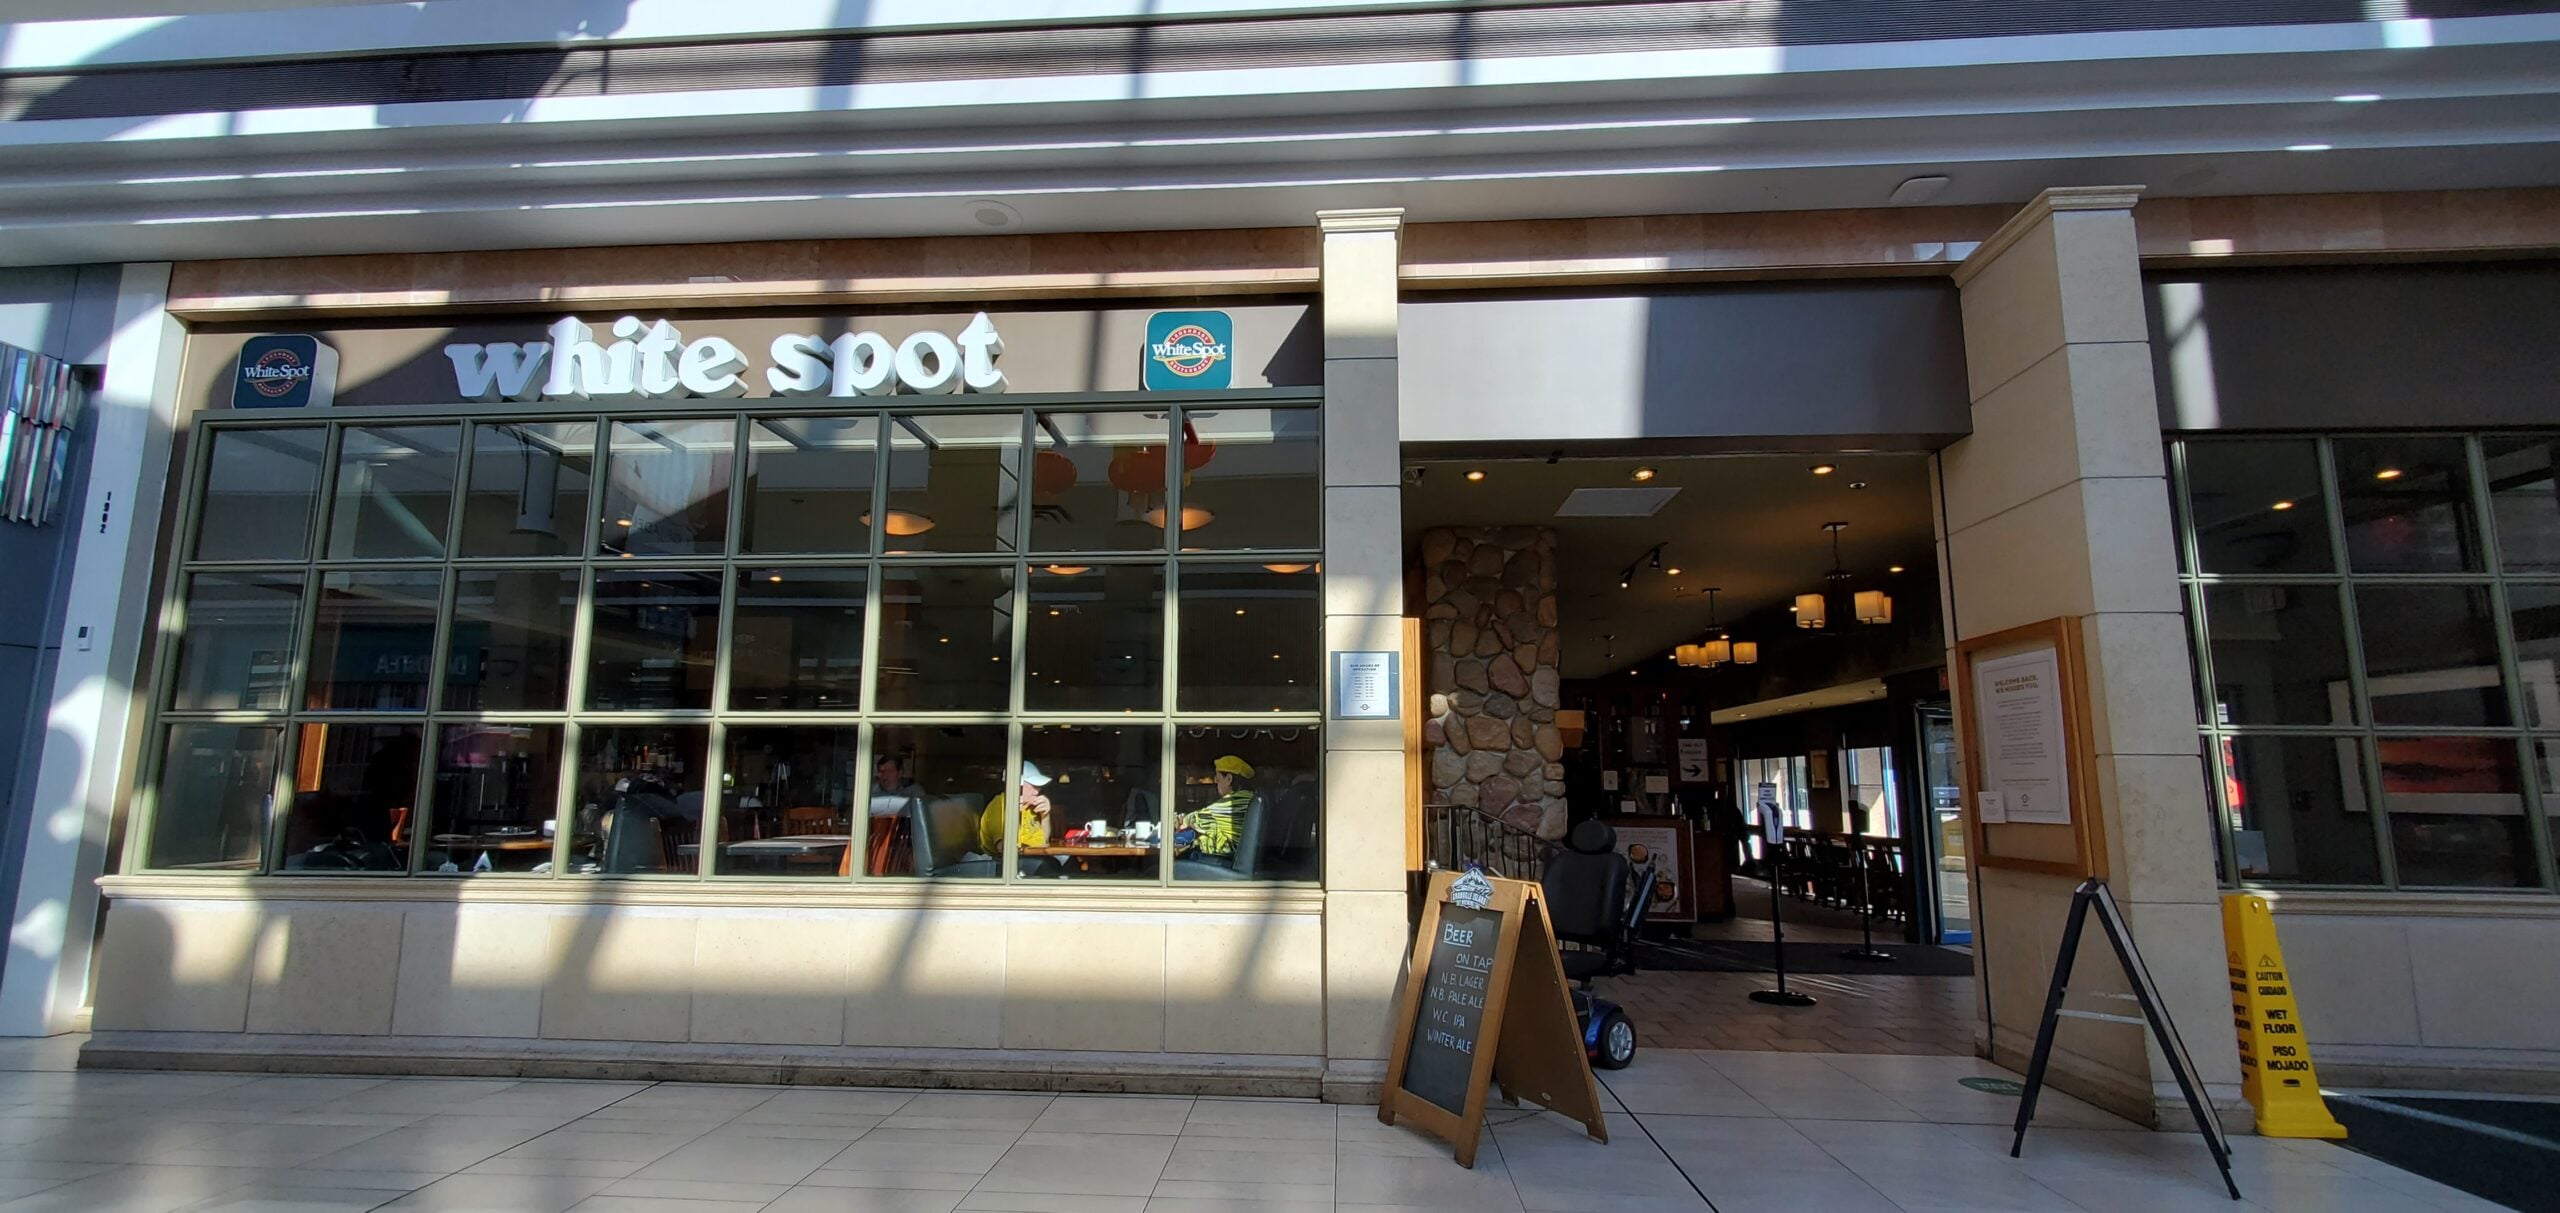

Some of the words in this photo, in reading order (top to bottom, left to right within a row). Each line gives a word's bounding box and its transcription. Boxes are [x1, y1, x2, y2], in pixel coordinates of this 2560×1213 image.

[444, 315, 748, 399] white
[767, 311, 1005, 398] spot
[1444, 923, 1473, 945] BEER
[1456, 953, 1470, 965] ON
[1473, 955, 1494, 969] TAP
[1459, 975, 1484, 990] LAGER
[2256, 971, 2284, 982] CAUTION
[2258, 985, 2288, 996] CUIDADO
[1447, 990, 1467, 1006] PALE
[1467, 995, 1484, 1009] ALE
[1453, 1013, 1465, 1029] IPA
[2265, 1009, 2287, 1020] WET
[2263, 1023, 2297, 1034] FLOOR
[1427, 1028, 1455, 1050] WINTER
[1455, 1038, 1473, 1055] ALE
[2272, 1045, 2296, 1056] PISO
[2266, 1060, 2309, 1071] MOJADO
